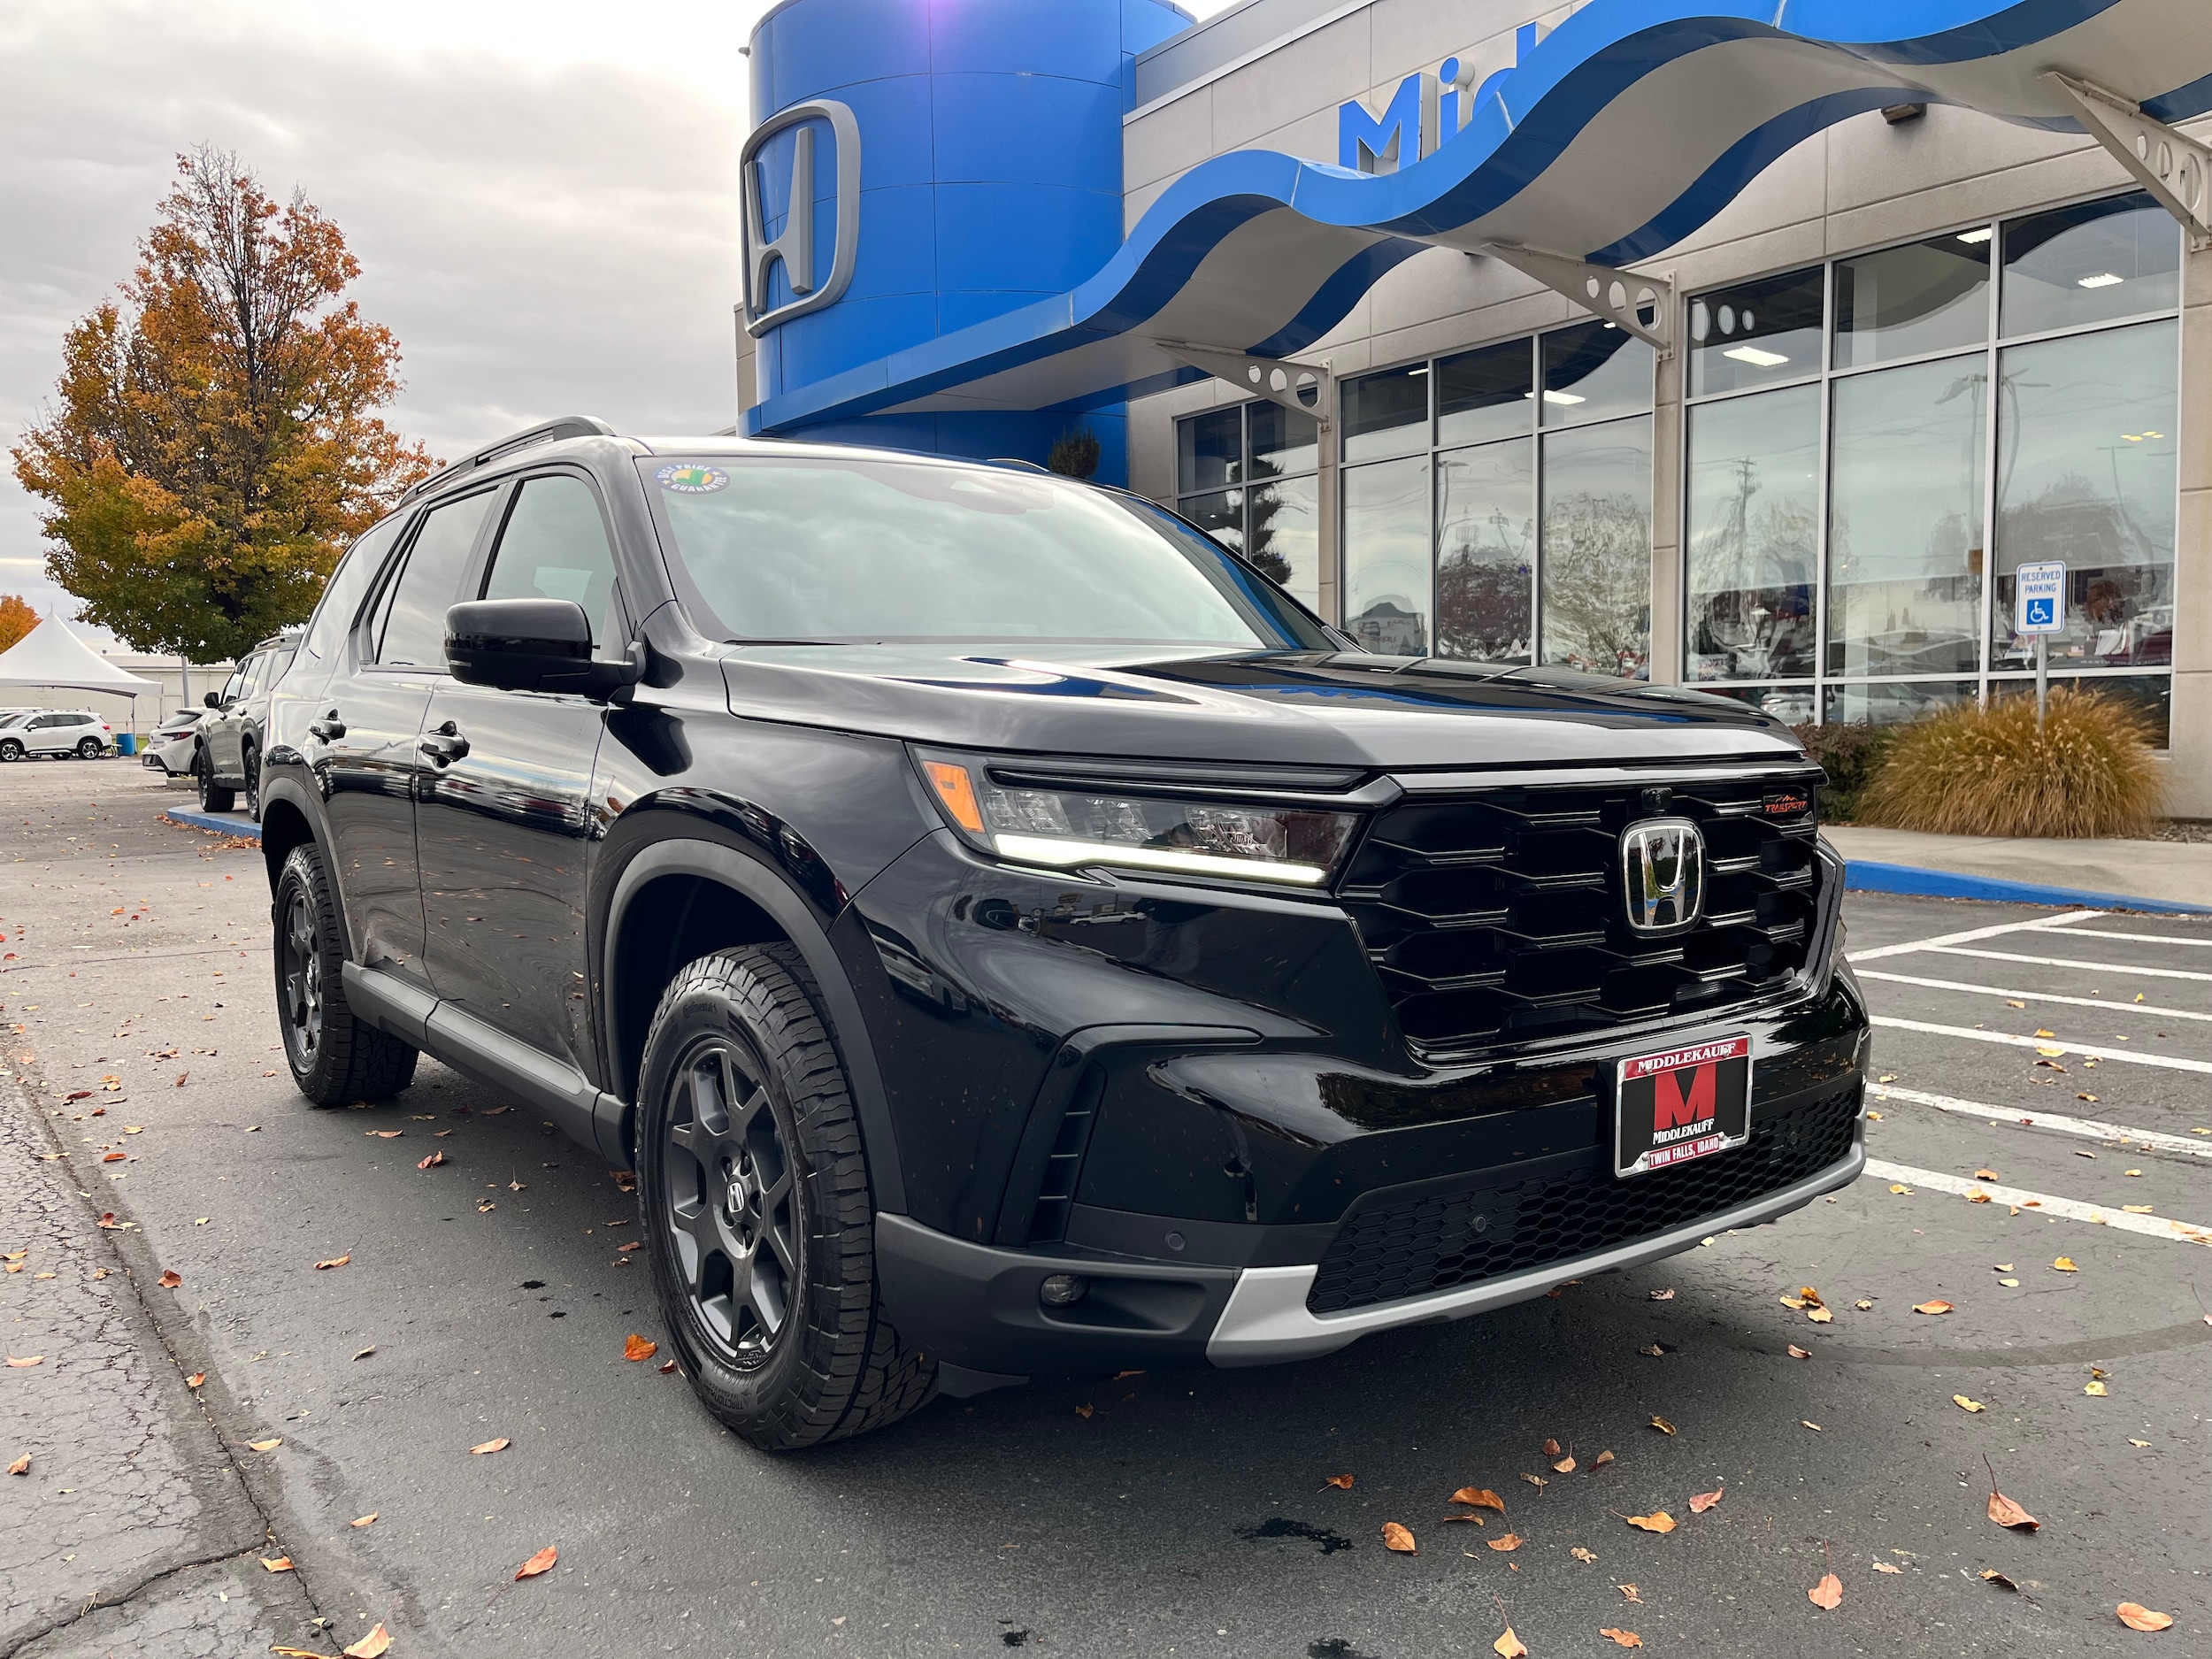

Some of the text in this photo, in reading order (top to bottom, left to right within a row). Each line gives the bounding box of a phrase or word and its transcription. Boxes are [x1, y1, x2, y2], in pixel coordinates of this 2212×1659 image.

[675, 464, 712, 472] PRICE
[671, 476, 727, 492] GUARANTEE
[2021, 570, 2061, 582] RESERVED
[2024, 583, 2056, 595] PARKING
[1765, 801, 1808, 813] TRAILSPORT
[1637, 1042, 1736, 1073] MIDDLEKAUFF
[1654, 1062, 1717, 1131] M
[1653, 1118, 1715, 1145] MIDDLEKAUFF
[1650, 1137, 1719, 1166] TWIN FALLS, IDAHO
